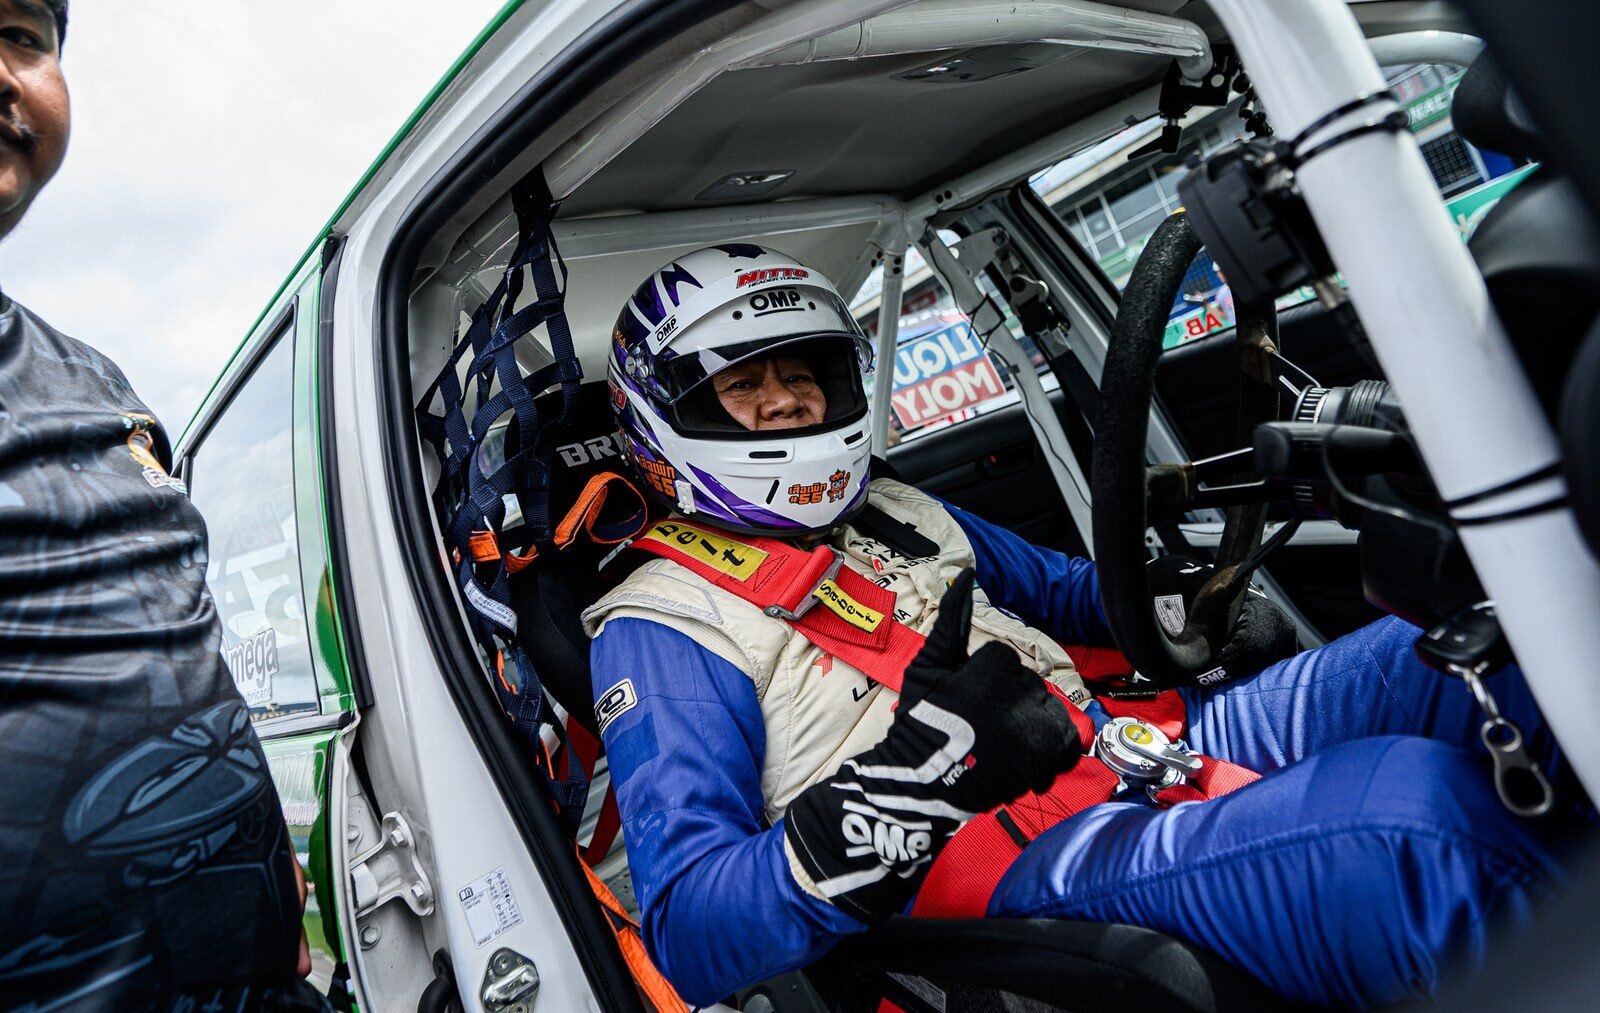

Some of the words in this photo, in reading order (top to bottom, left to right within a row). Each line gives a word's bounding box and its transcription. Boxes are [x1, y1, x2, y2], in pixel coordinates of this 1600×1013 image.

[736, 267, 809, 289] NITTO
[749, 290, 801, 311] OMP
[656, 317, 677, 342] OMP
[556, 431, 626, 468] BRI
[789, 492, 823, 505] #55
[221, 632, 277, 689] mega
[1199, 668, 1227, 686] OMP
[841, 812, 931, 862] OMP
